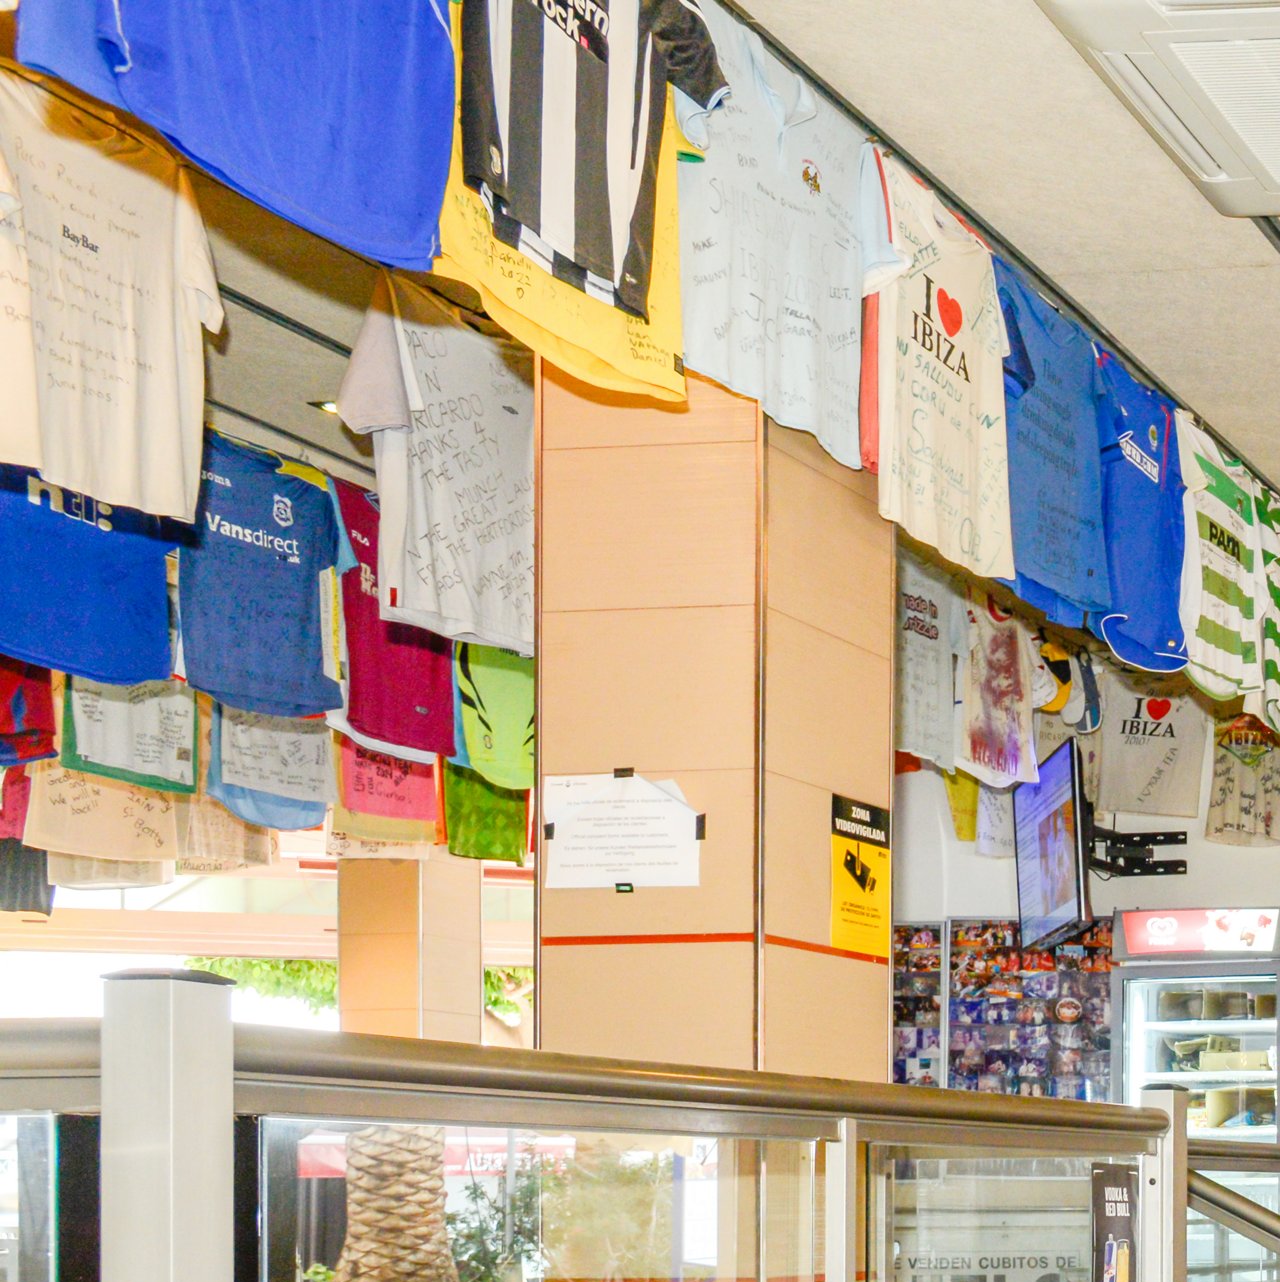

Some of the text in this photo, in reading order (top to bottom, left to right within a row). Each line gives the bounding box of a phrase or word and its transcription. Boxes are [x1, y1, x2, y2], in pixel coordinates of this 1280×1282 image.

[923, 272, 935, 324] I
[911, 309, 972, 385] IBIZA
[413, 393, 484, 432] RICARDO
[421, 461, 455, 492] THE
[453, 494, 499, 534] GREAT
[205, 511, 300, 556] Vansdirect
[351, 528, 371, 547] FILA
[1132, 697, 1146, 720] I
[1119, 719, 1177, 739] IBIZA
[851, 806, 871, 823] ZONA
[834, 817, 887, 843] VIDEOVIGILADA
[1104, 1186, 1129, 1202] VODKA &
[1105, 1202, 1131, 1217] RED BULL
[908, 1256, 972, 1270] VENDEN
[978, 1256, 1048, 1271] CUBITOS
[1056, 1256, 1077, 1269] DE
